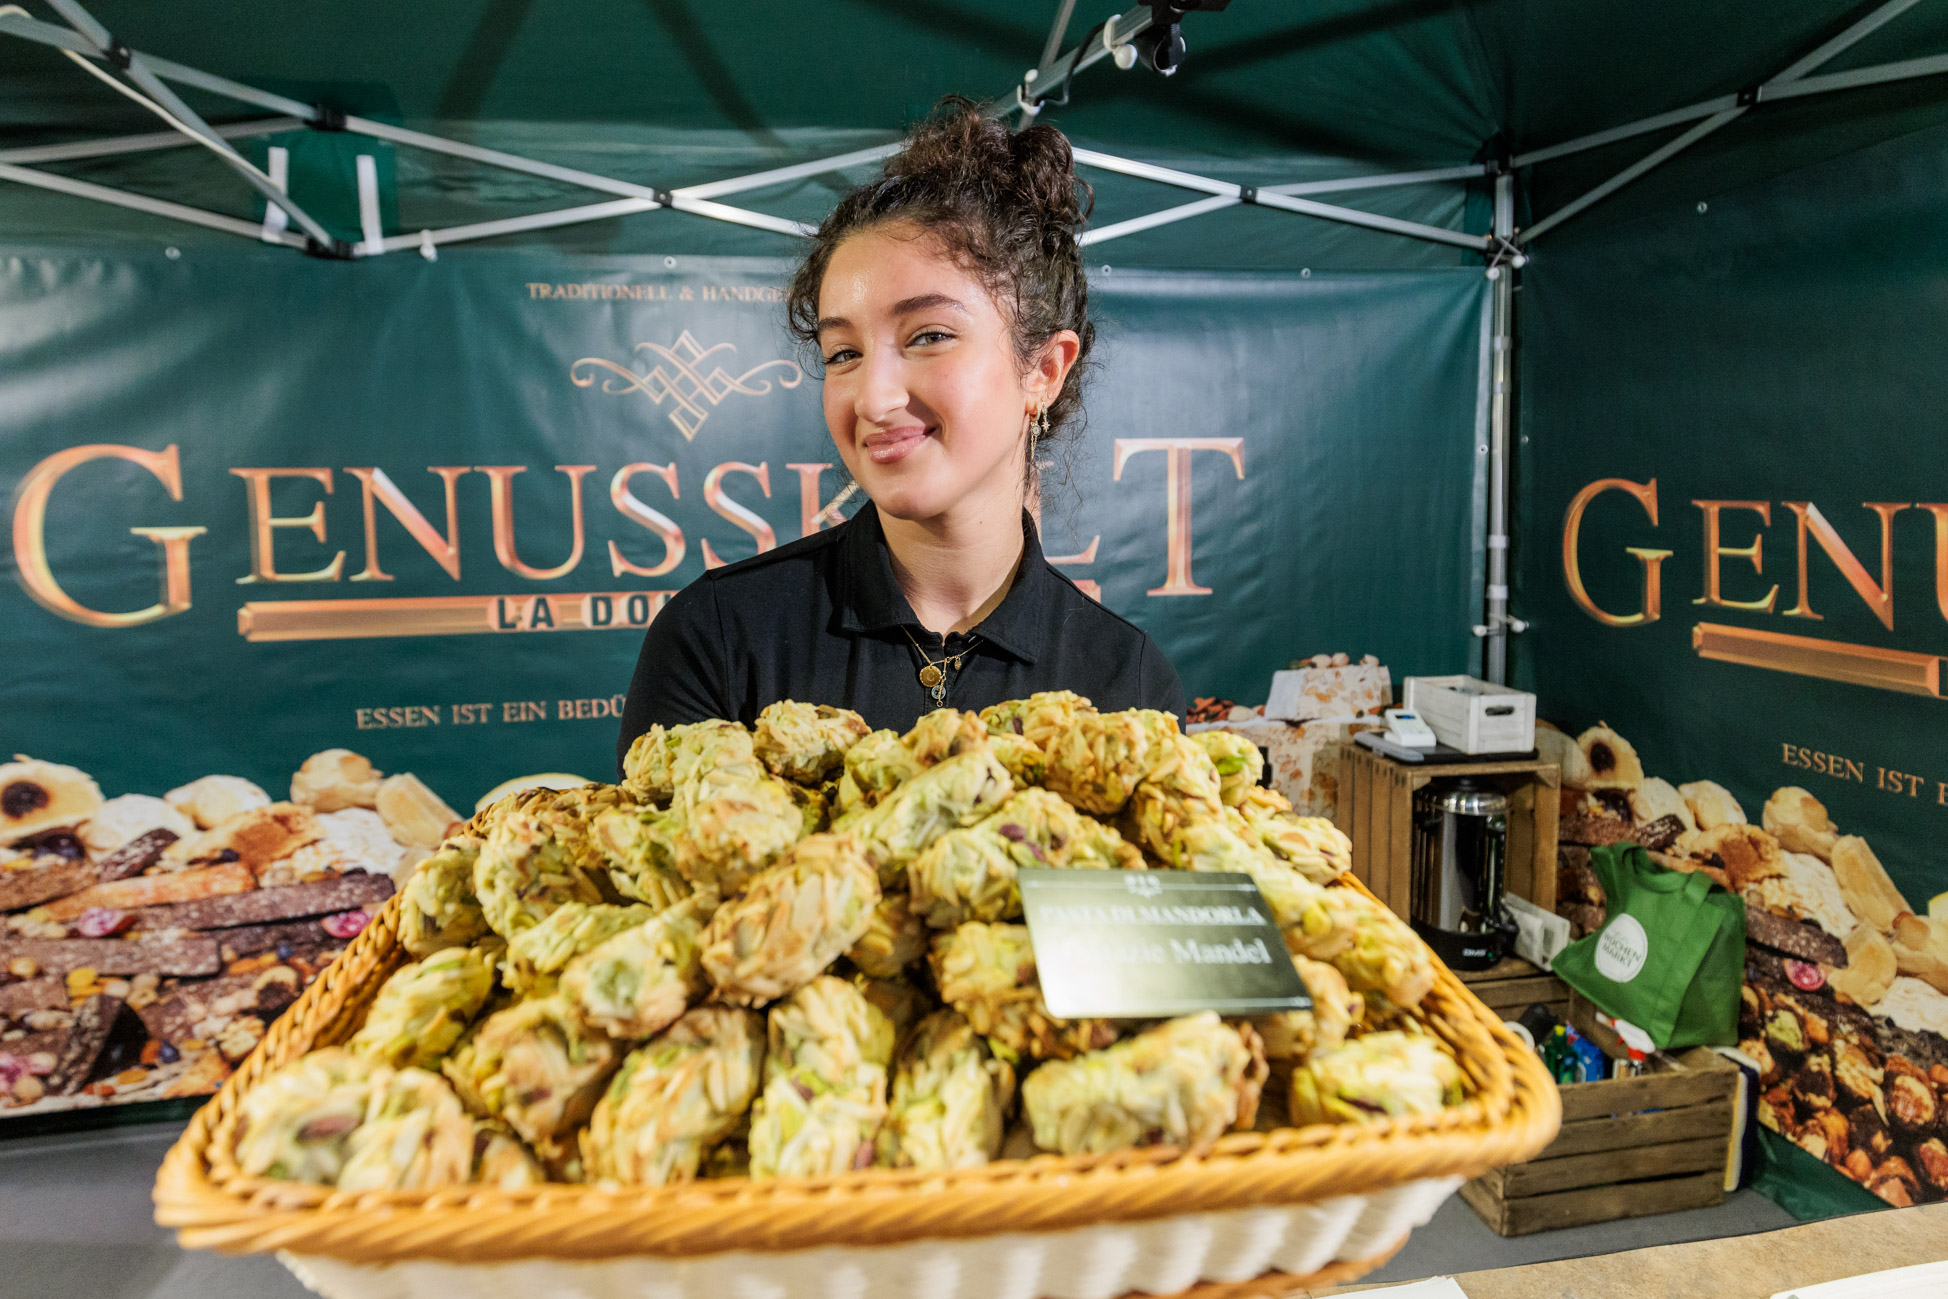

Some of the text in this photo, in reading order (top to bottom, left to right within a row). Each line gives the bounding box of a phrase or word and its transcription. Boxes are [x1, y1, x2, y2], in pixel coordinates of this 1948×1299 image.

[525, 282, 672, 301] TRADITIONELL
[678, 285, 695, 301] &
[497, 594, 671, 630] LA DO
[356, 705, 441, 730] ESSEN
[451, 703, 493, 725] IST
[502, 701, 547, 723] EIN
[1782, 743, 1864, 784] ESSEN
[1877, 766, 1925, 798] IST
[1169, 937, 1272, 964] Mandel
